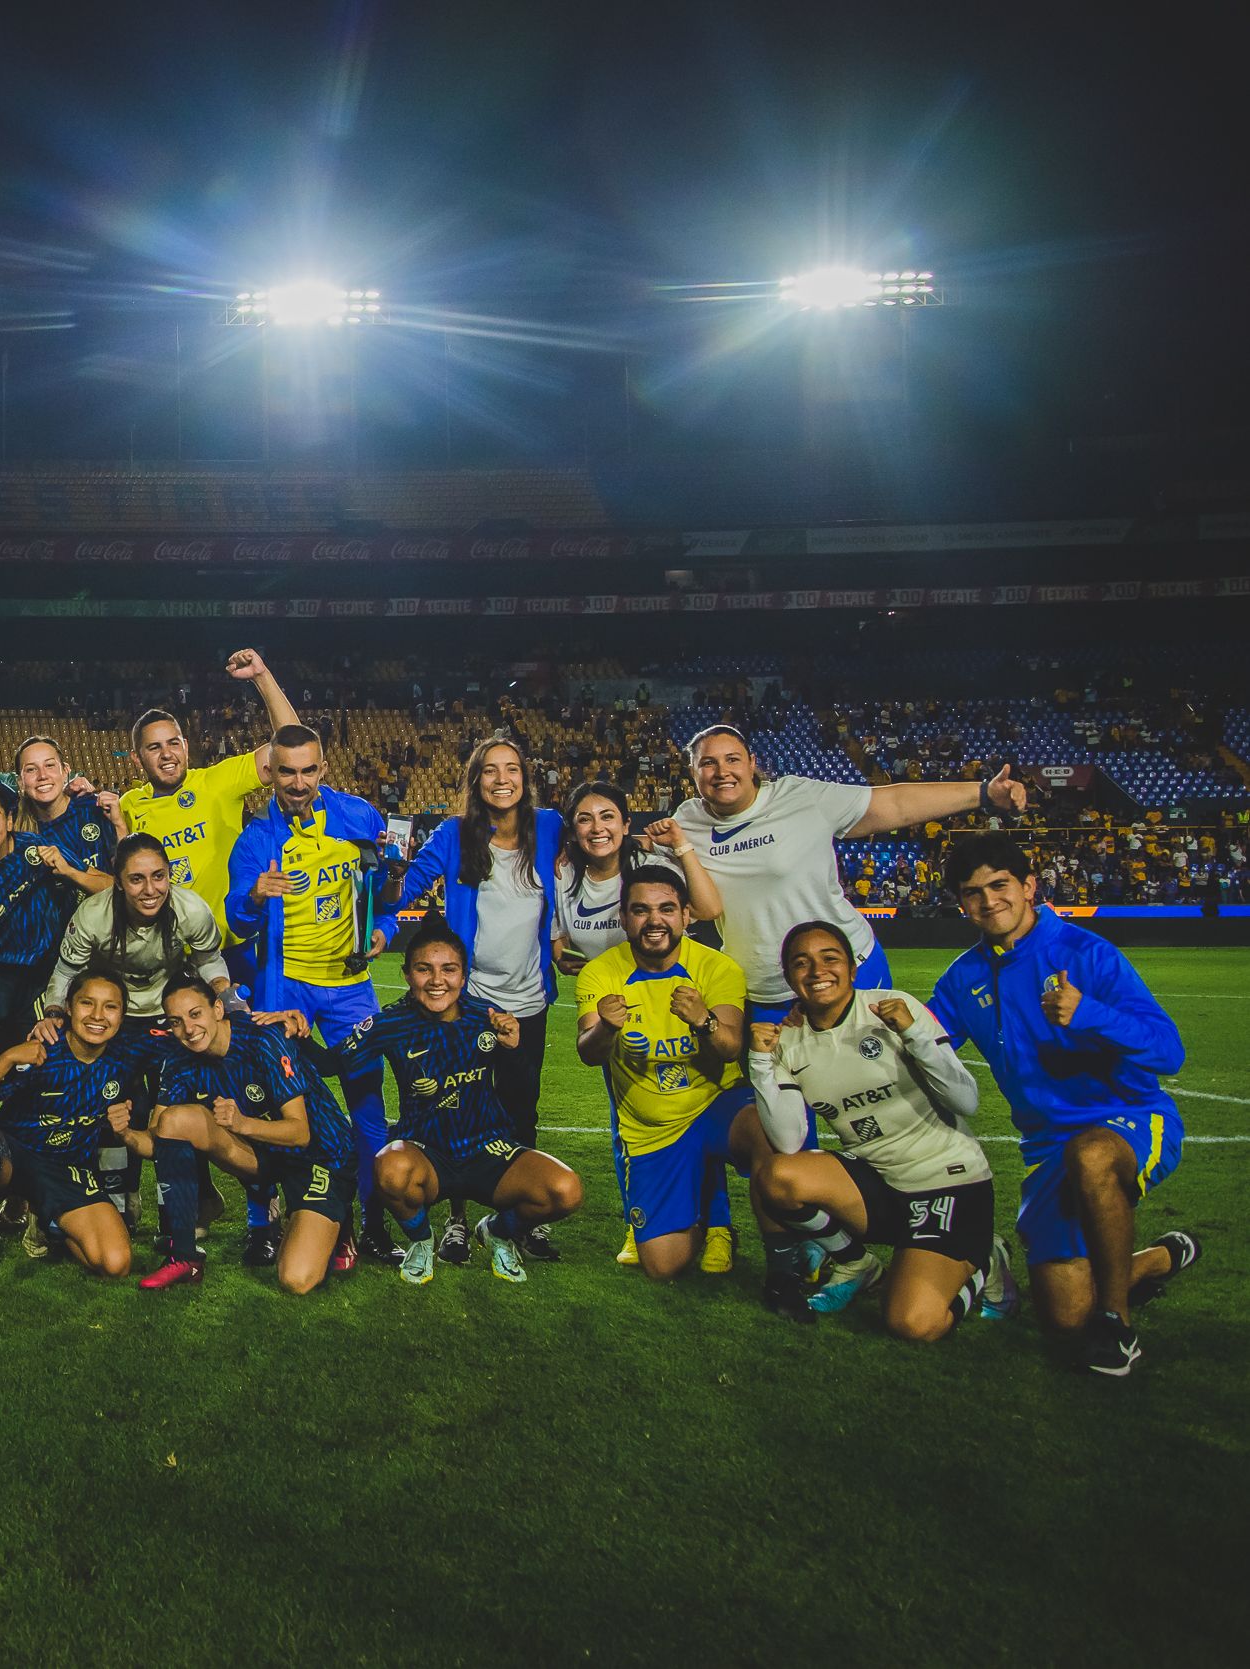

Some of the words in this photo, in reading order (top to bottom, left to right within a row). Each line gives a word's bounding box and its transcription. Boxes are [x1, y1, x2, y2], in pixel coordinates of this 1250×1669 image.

[44, 600, 109, 617] AFIRME
[157, 601, 221, 617] AFIRME
[230, 601, 275, 616] TECATE
[326, 600, 374, 616] TECATE
[424, 600, 471, 614] TECATE
[524, 599, 570, 613] TECATE
[623, 598, 670, 612] TECATE
[724, 595, 773, 609] TECATE
[826, 592, 875, 606] TECATE
[931, 589, 981, 605] TECATE
[1038, 584, 1090, 601] TECATE
[1149, 580, 1202, 597] TECATE
[161, 822, 207, 849] AT&T
[709, 844, 730, 856] CLUB
[732, 834, 775, 853] AMÉRICA
[317, 896, 337, 920] HOME
[573, 919, 591, 930] CLUB
[593, 918, 620, 931] AMÉRI
[655, 1036, 696, 1057] AT&
[444, 1067, 487, 1089] AT&T
[660, 1064, 683, 1089] HOME
[841, 1084, 893, 1112] AT&T
[308, 1163, 331, 1195] 5
[909, 1196, 955, 1232] 54
